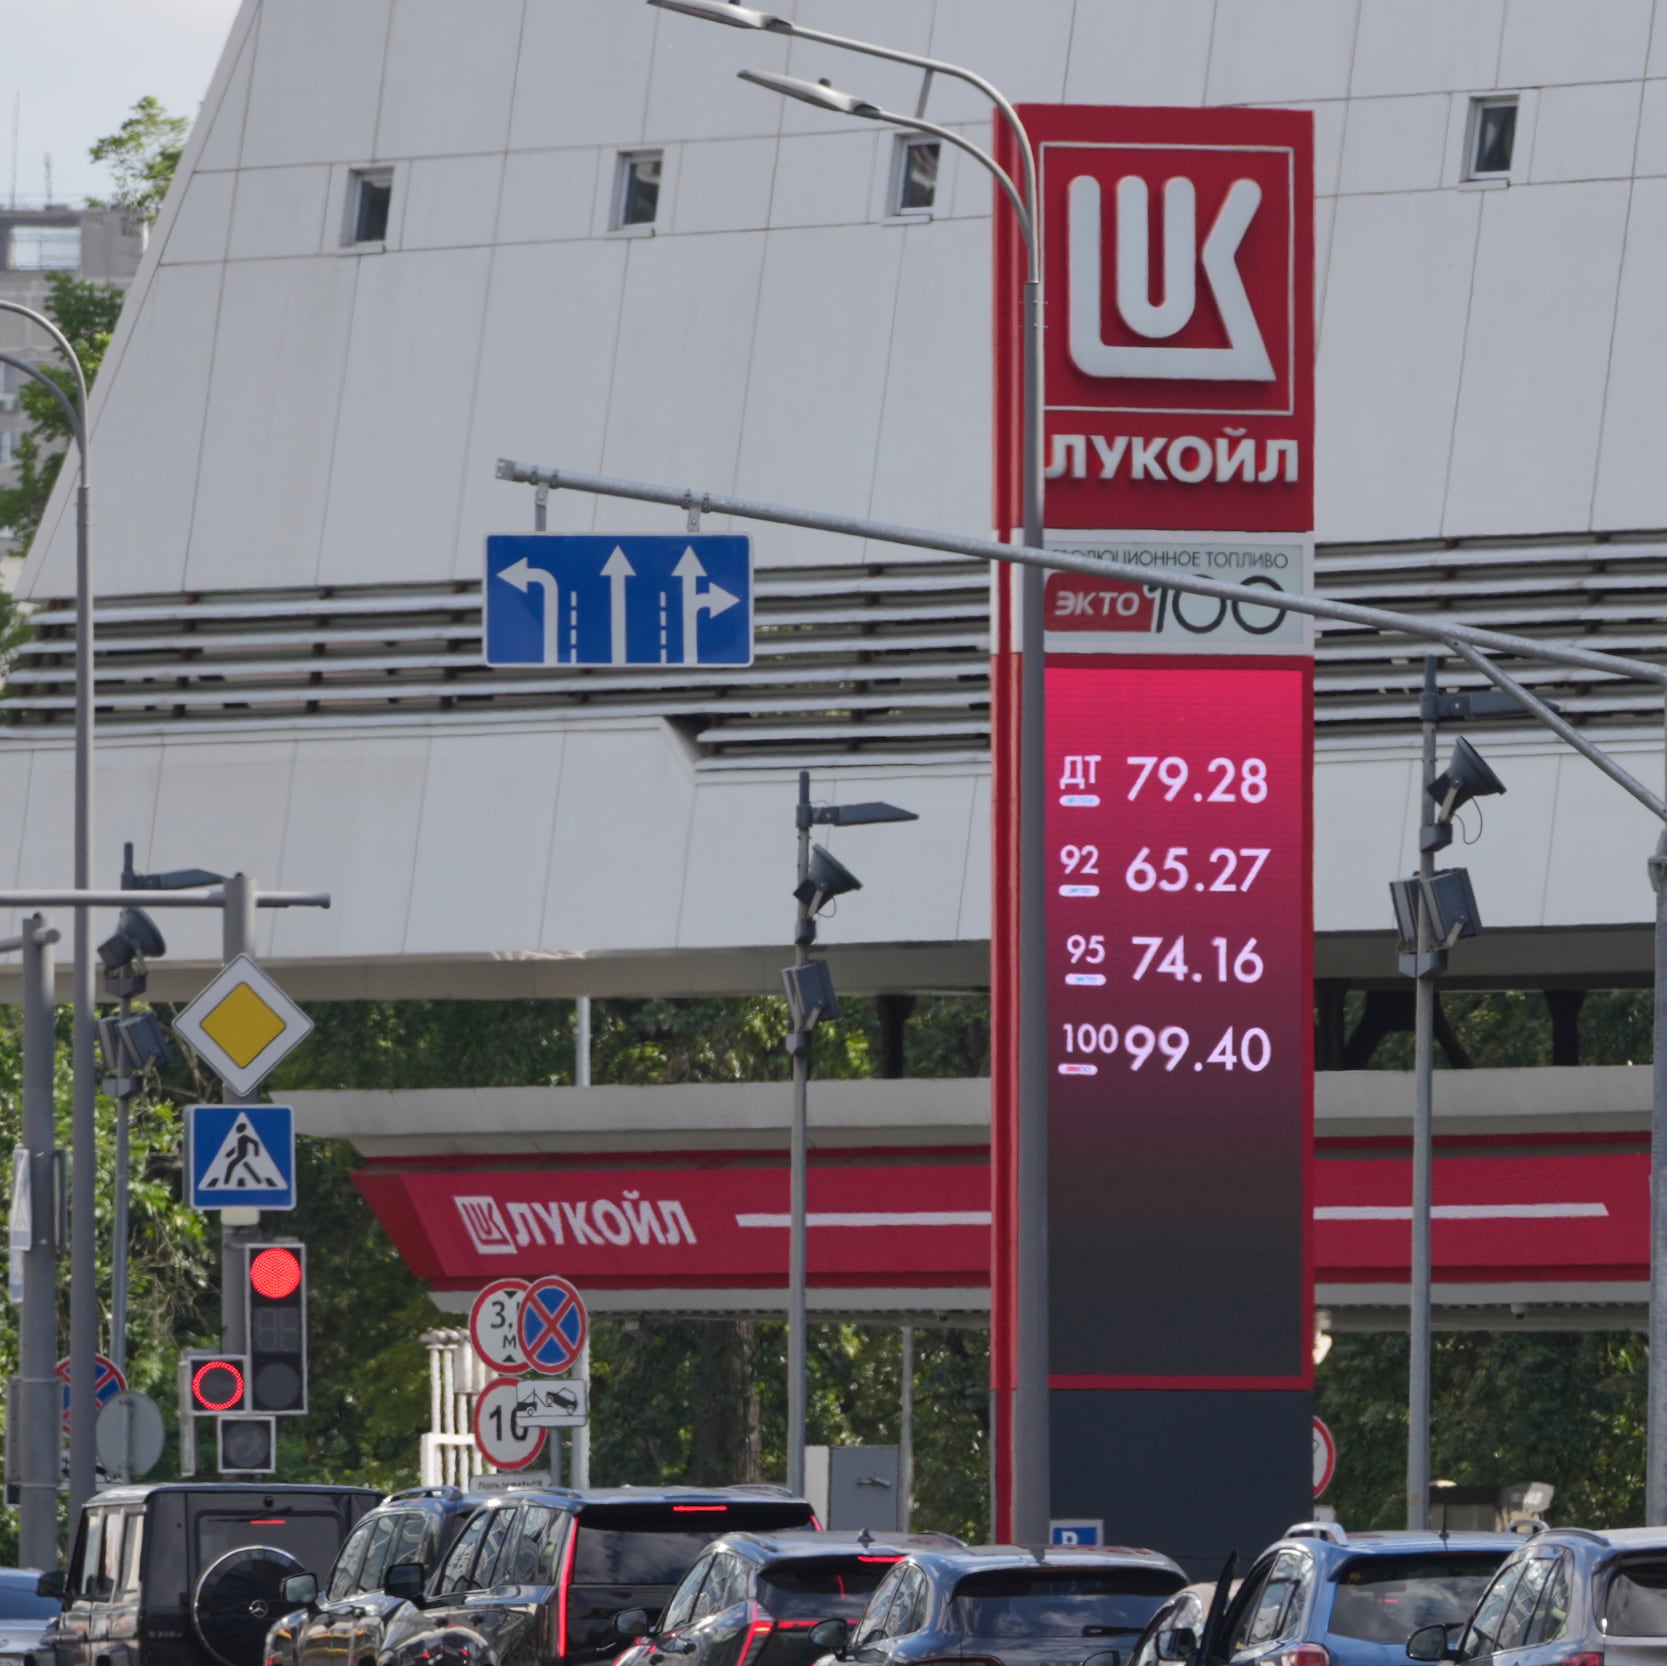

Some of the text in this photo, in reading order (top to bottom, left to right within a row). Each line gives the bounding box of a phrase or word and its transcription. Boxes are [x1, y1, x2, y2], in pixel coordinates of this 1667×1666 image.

[1045, 427, 1299, 484] ЛУКОЙЛ
[1206, 550, 1289, 569] ТОПЛИВО
[1054, 590, 1140, 616] ЭКТО
[1059, 754, 1268, 804] ДТ 79.28
[1060, 844, 1272, 893] 92 65.27
[1066, 934, 1265, 984] 95 74.16
[1062, 1022, 1272, 1073] 100 99.40
[506, 1190, 698, 1247] ЛУКОЙЛ
